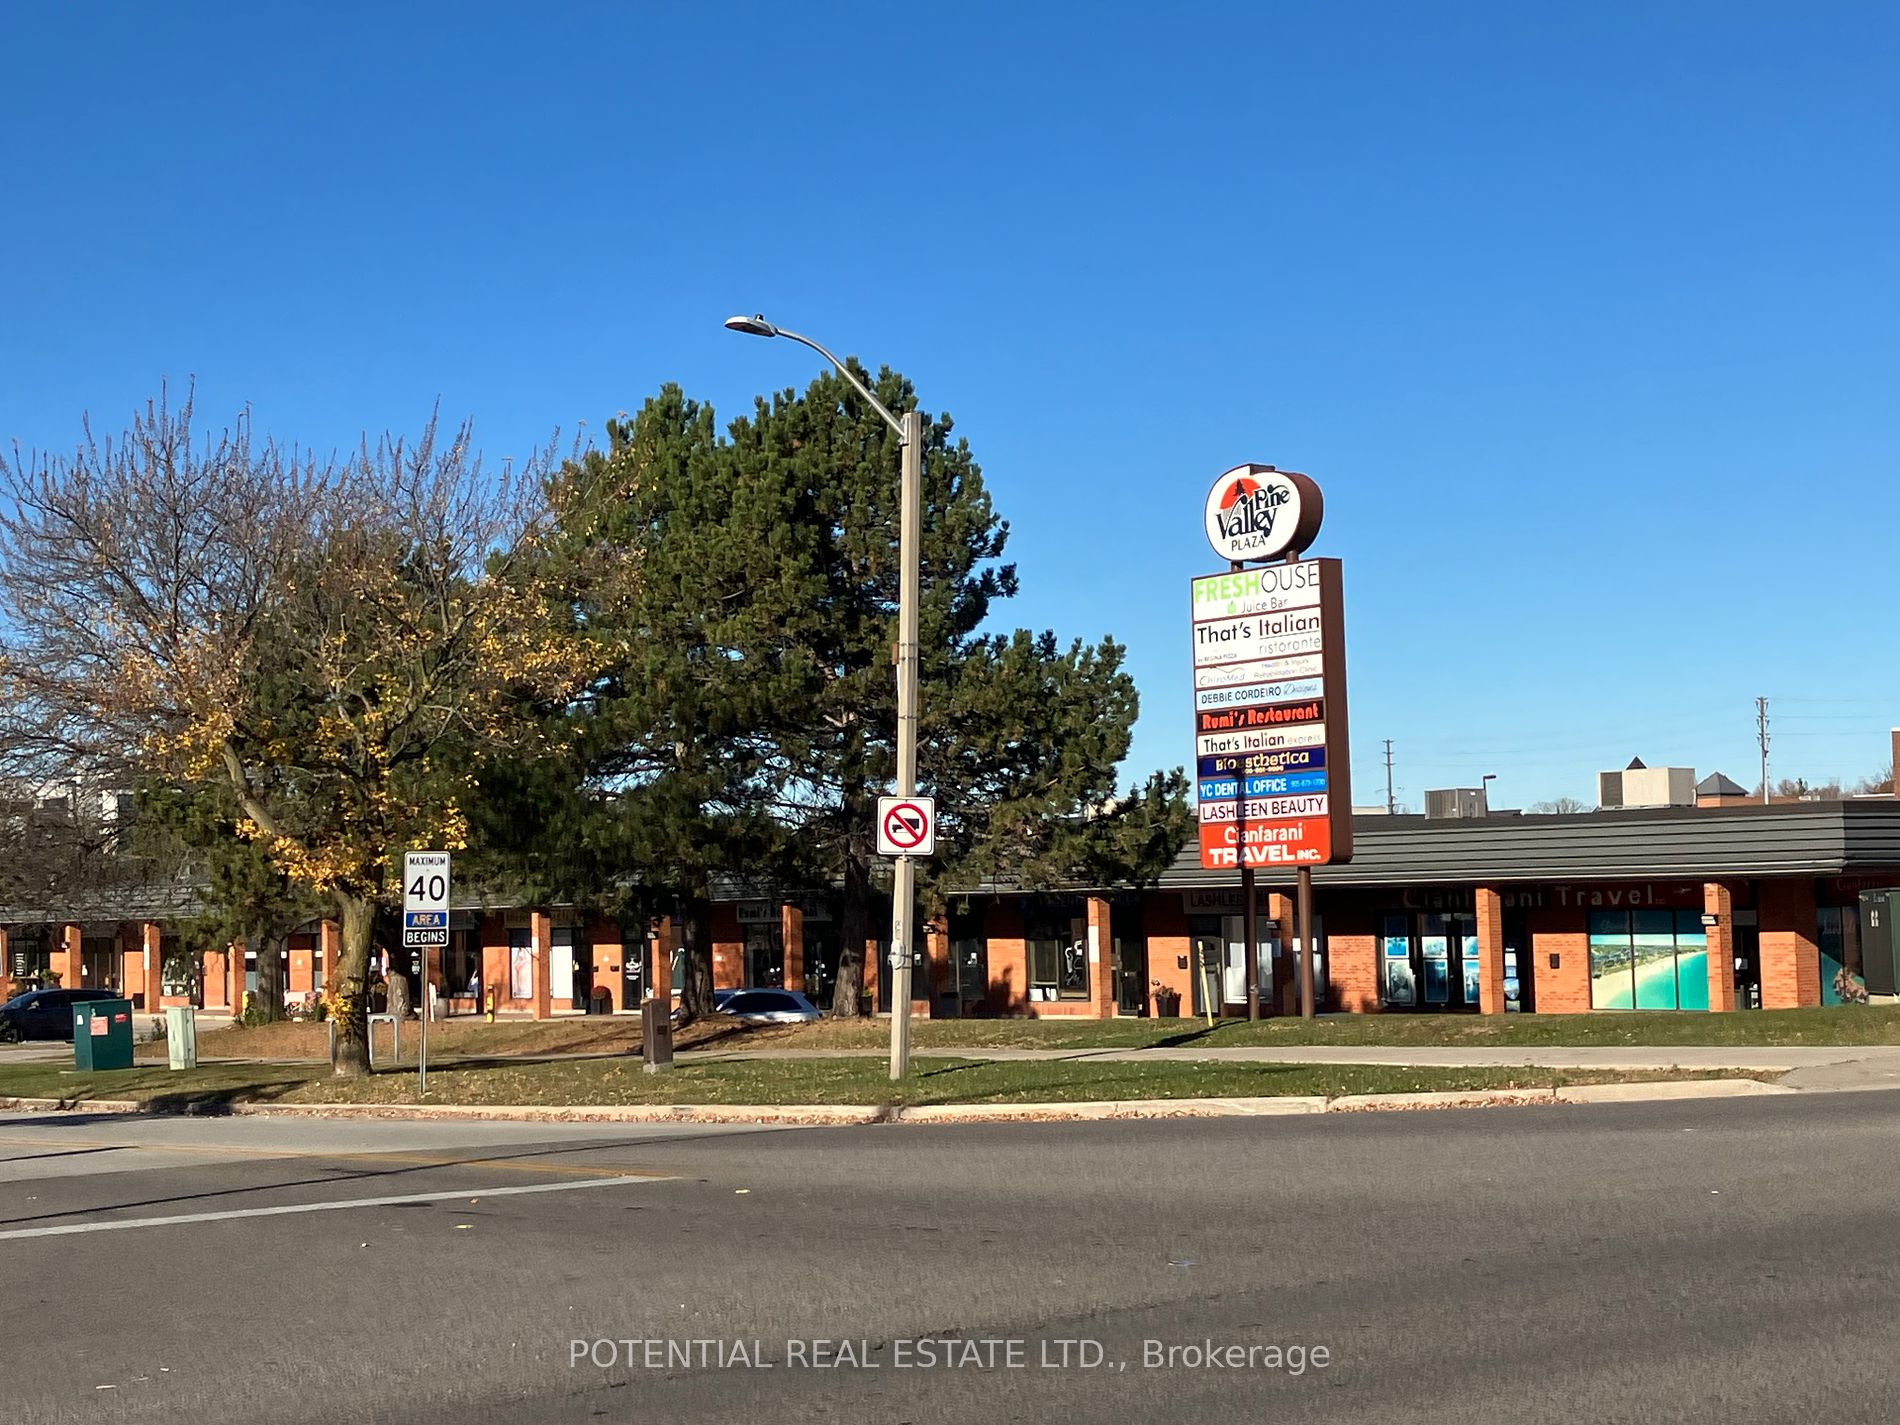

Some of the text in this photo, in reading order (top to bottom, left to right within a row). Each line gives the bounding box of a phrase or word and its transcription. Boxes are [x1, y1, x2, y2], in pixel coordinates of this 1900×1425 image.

[1254, 484, 1290, 511] Pine
[1216, 495, 1277, 540] Valley
[1231, 535, 1265, 552] PLAZA
[1241, 597, 1288, 613] Juice Bar
[1197, 614, 1319, 644] That's Italian
[1201, 691, 1233, 705] DEBBIE
[1235, 686, 1281, 701] CORDEIRO
[1248, 703, 1319, 725] Restaurant
[1204, 738, 1240, 753] That's
[1244, 732, 1285, 748] Italian
[1200, 785, 1213, 798] YC
[1215, 780, 1252, 797] DENTAL
[1253, 778, 1287, 793] OFFICE
[1202, 797, 1324, 821] LASHLEEN BEAUTY
[1224, 822, 1303, 844] Cianfarani
[409, 856, 446, 866] MAXIMUM
[1209, 843, 1321, 866] TRAVEL INC.
[409, 875, 445, 902] 40
[1555, 883, 1655, 907] Travel
[412, 913, 440, 926] AREA
[407, 931, 446, 944] BEGINS
